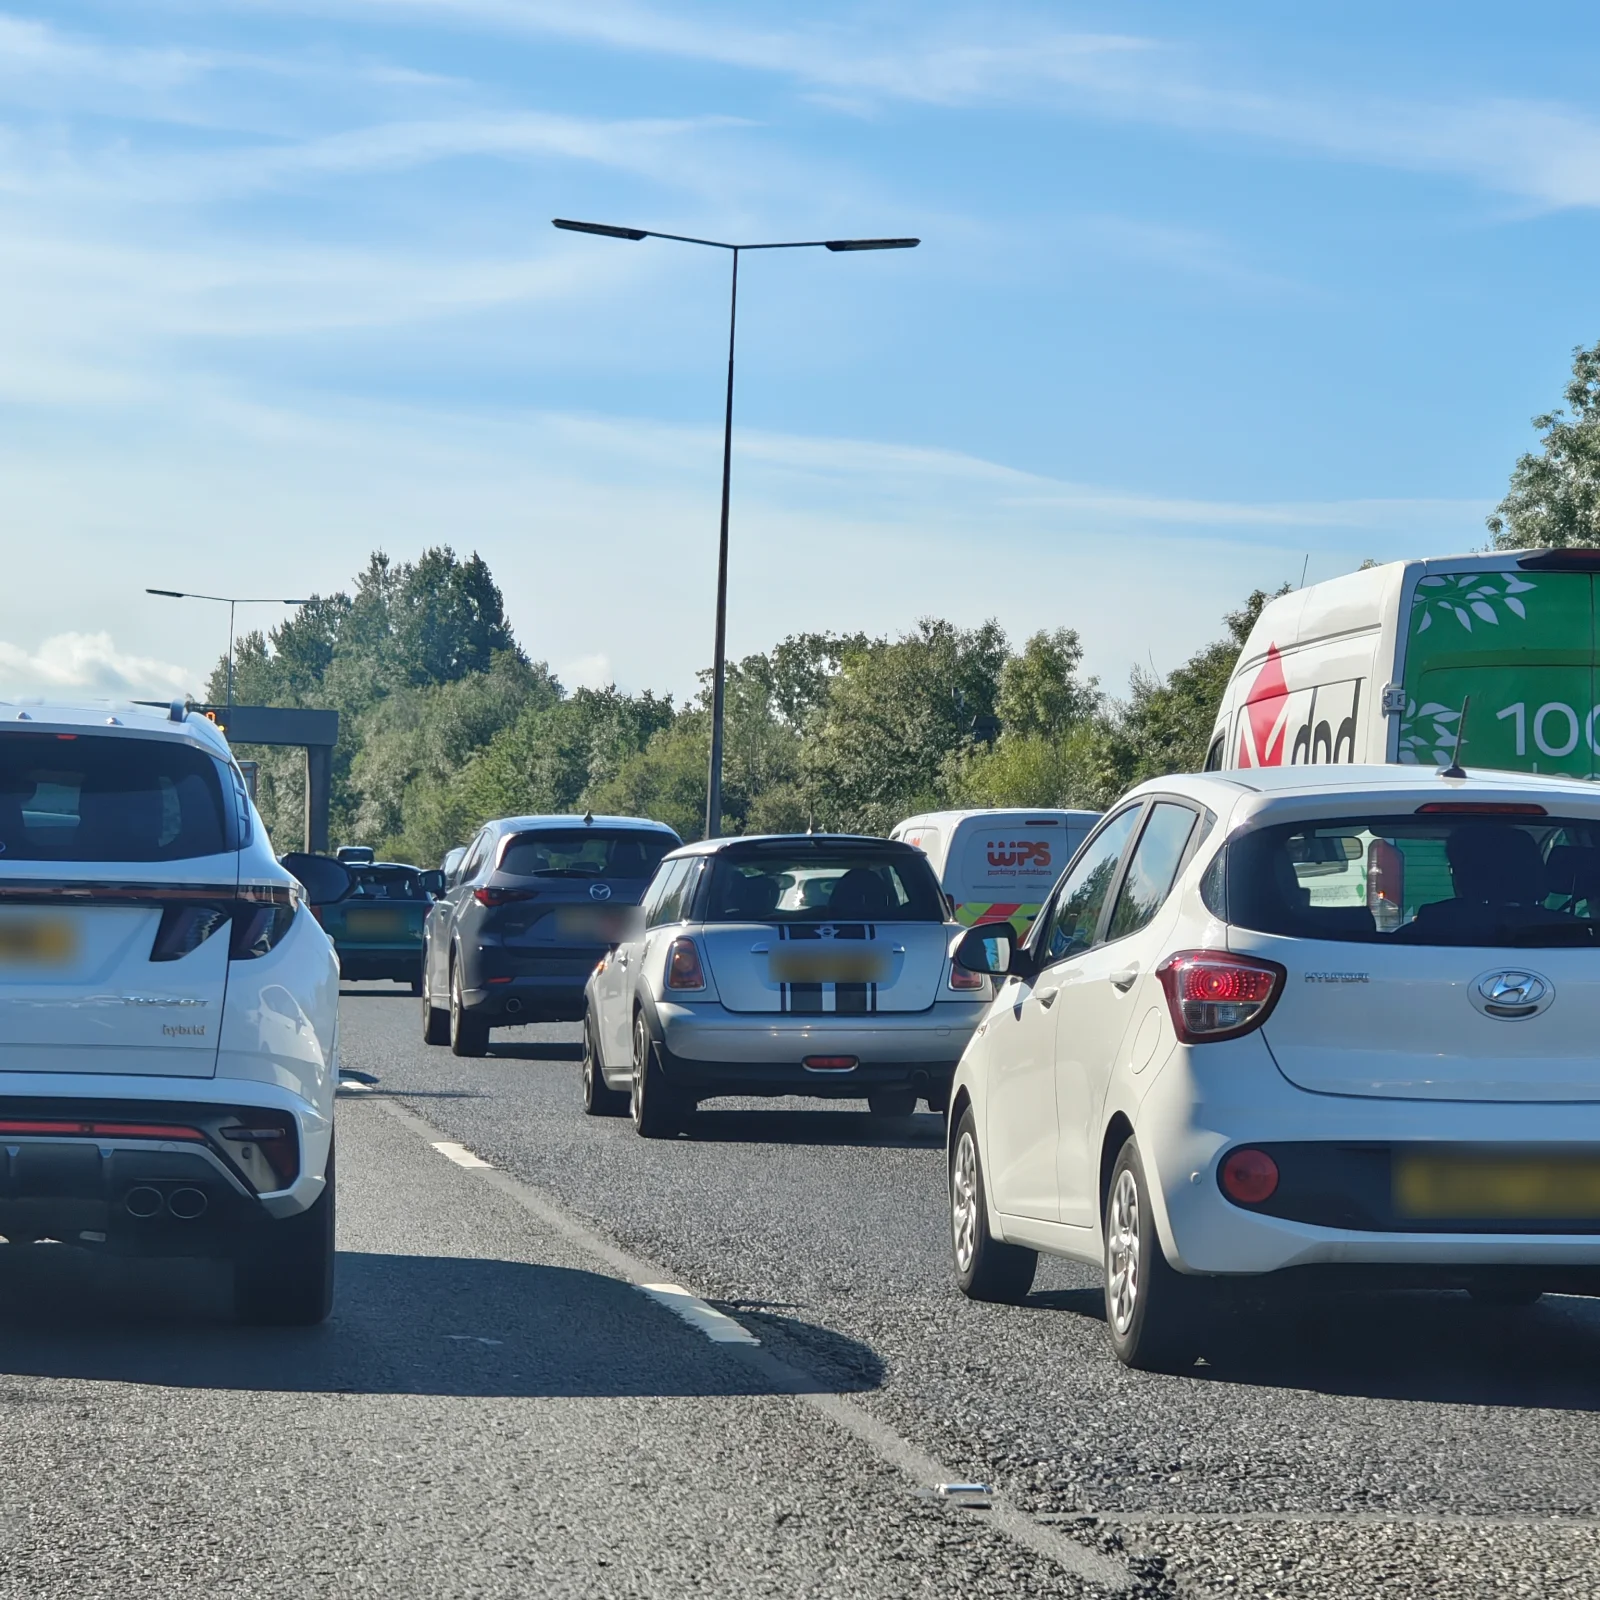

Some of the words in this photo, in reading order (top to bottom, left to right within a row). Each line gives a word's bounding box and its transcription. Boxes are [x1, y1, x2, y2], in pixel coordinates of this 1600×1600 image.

[987, 841, 1051, 866] WPS
[988, 868, 1016, 876] parking
[1018, 868, 1052, 876] solutions
[162, 1024, 205, 1037] hybrid
